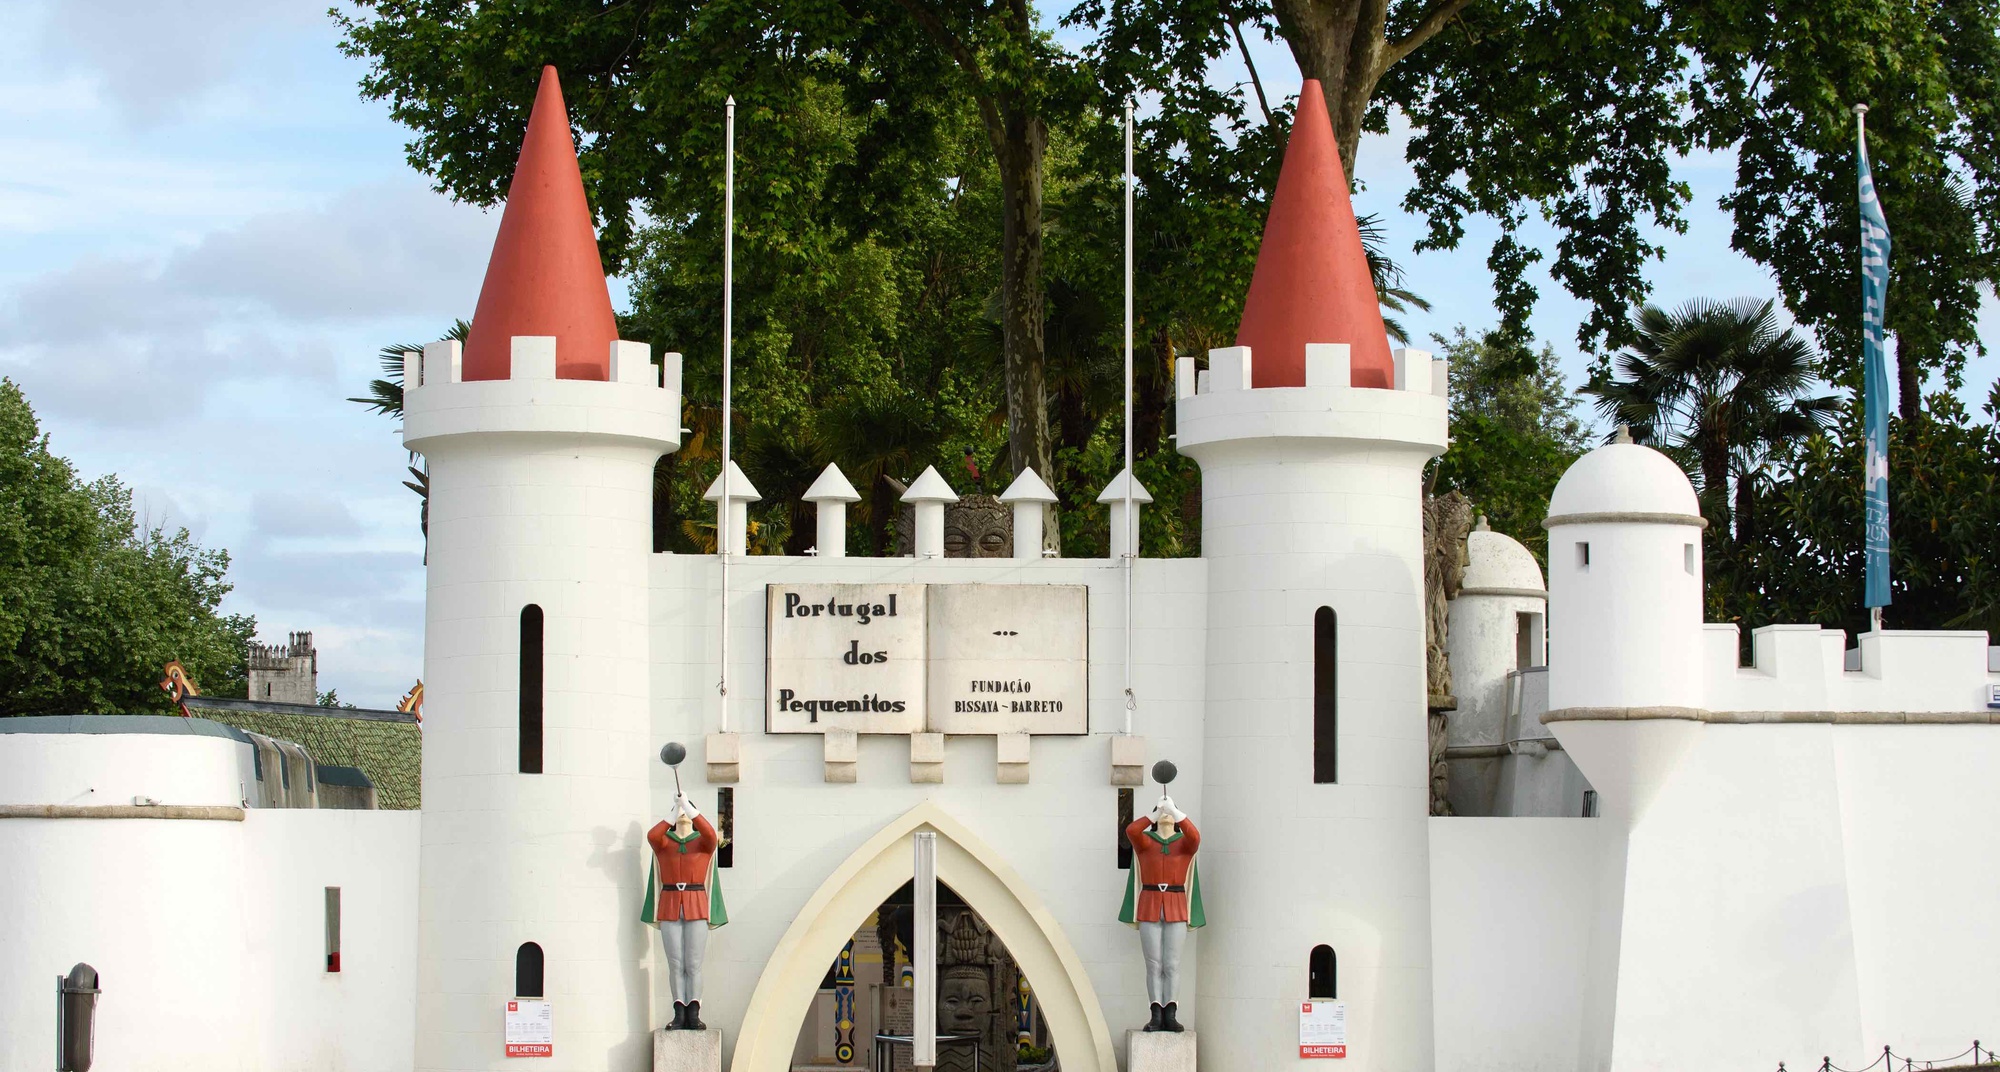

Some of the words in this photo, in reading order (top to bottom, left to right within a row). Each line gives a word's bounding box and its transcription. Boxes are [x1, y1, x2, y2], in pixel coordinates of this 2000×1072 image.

[784, 592, 898, 625] Portugal
[843, 640, 888, 665] dos
[971, 678, 1031, 694] FUNDAÇÃO
[778, 689, 906, 722] Pequenitos
[954, 700, 999, 713] BISSAYA
[1011, 700, 1063, 713] BARRETO
[508, 1045, 549, 1053] BILHETEIRA
[1302, 1046, 1344, 1054] BILHETEIRA
